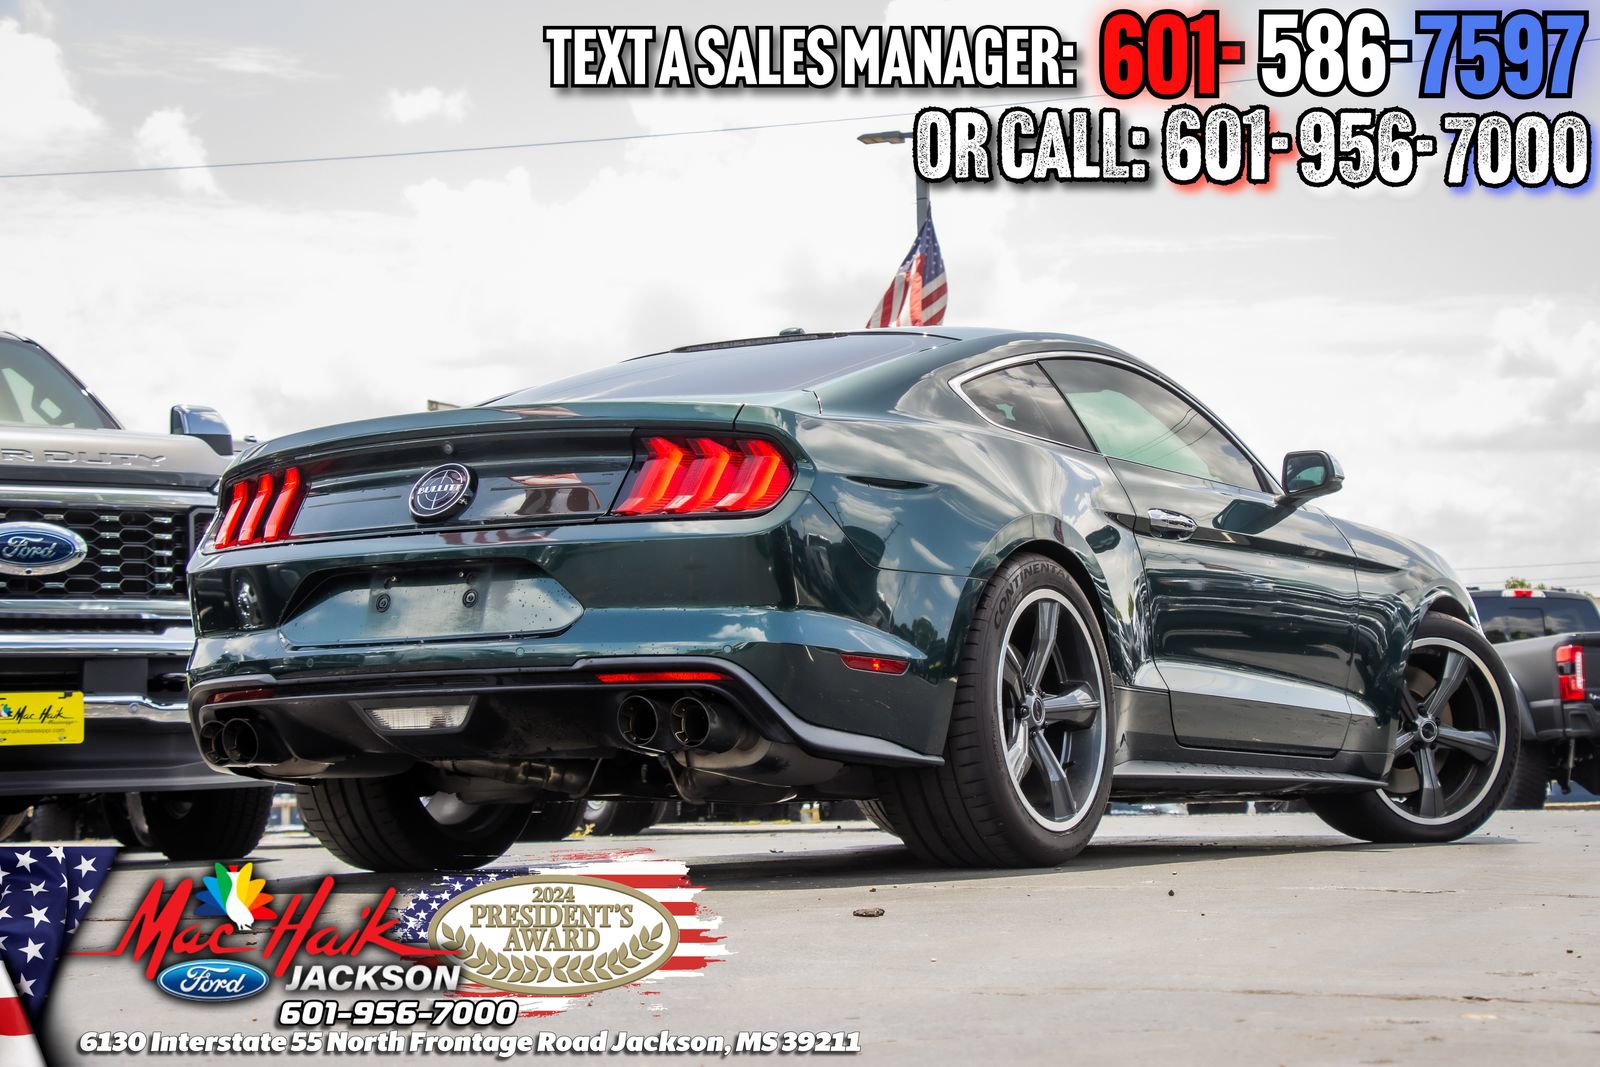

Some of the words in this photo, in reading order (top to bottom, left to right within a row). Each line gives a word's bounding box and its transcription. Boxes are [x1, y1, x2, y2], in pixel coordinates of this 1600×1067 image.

[44, 449, 167, 467] DUTY
[2, 536, 58, 559] Ford
[993, 562, 1075, 631] CONTINENTAL
[12, 704, 35, 724] Mac
